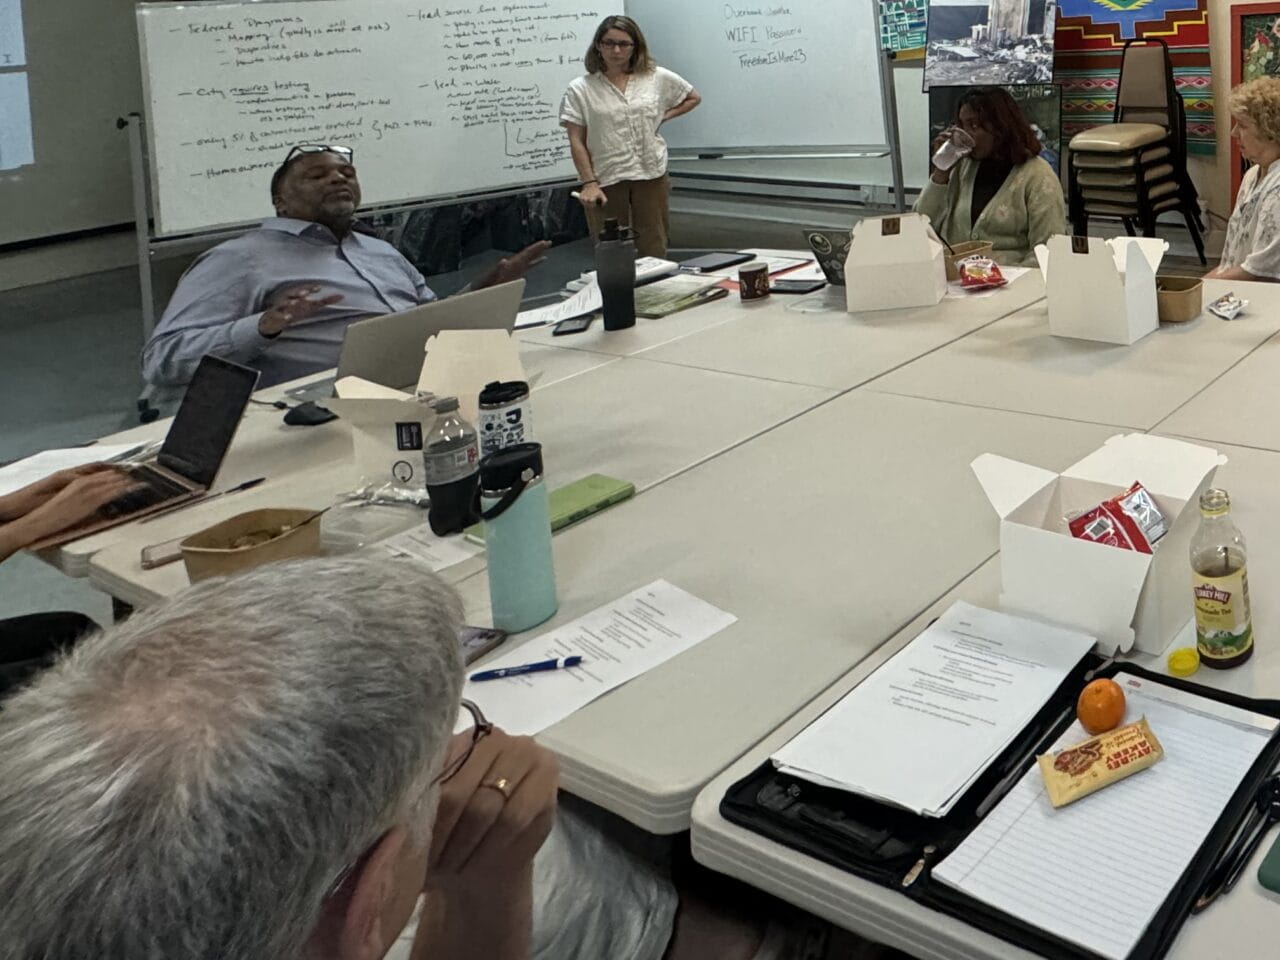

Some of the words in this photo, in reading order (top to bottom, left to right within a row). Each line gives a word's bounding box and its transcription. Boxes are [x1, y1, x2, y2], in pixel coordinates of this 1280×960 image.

[726, 26, 759, 43] WIFI
[196, 87, 226, 99] City
[1106, 740, 1147, 763] AKERY
